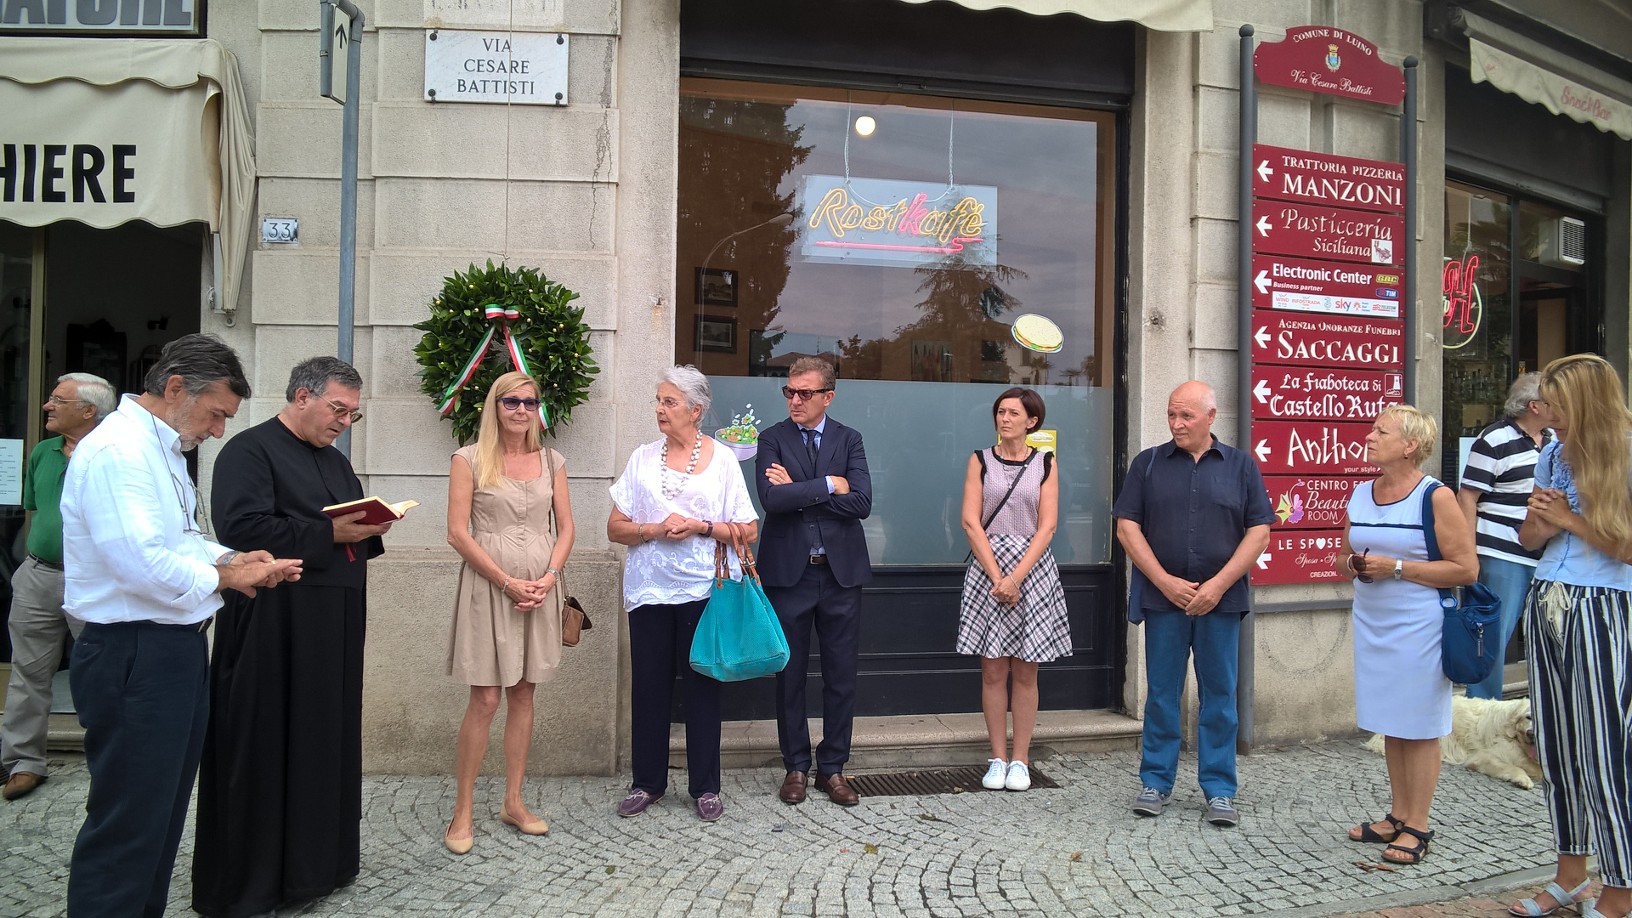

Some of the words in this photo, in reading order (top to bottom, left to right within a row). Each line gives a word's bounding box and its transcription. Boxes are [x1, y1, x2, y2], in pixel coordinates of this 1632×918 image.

[482, 38, 513, 53] VIA
[1293, 29, 1330, 43] COMUNE
[1333, 31, 1343, 40] DI
[1346, 35, 1372, 56] LUINO
[464, 59, 530, 74] CESARE
[457, 79, 535, 95] BATTISTI
[1290, 69, 1308, 83] Via
[1310, 72, 1338, 90] Cesare
[1339, 77, 1374, 96] Battisti
[1282, 155, 1347, 174] TRATTORIA
[1352, 165, 1403, 181] PIZZERIA
[1282, 172, 1403, 206] MANZONI
[268, 222, 291, 239] 33
[1281, 208, 1393, 240] Pasticceria
[1312, 236, 1372, 257] Siciliana
[1272, 263, 1332, 281] Electronic
[1333, 269, 1373, 285] Center
[1273, 281, 1299, 290] Business
[1335, 298, 1352, 312] sky
[1279, 319, 1316, 331] AGENZIA
[1318, 322, 1363, 334] ONORANZE
[1365, 324, 1401, 336] FUNEBRI
[1277, 330, 1400, 364] SACCAGGI
[1280, 373, 1301, 389] La
[1269, 393, 1345, 417] Castello
[1345, 395, 1398, 418] Rut
[1360, 466, 1376, 474] style
[1307, 480, 1348, 491] CENTRO
[1308, 511, 1339, 521] ROOM
[1278, 539, 1293, 551] LE
[1295, 552, 1319, 568] Sposa
